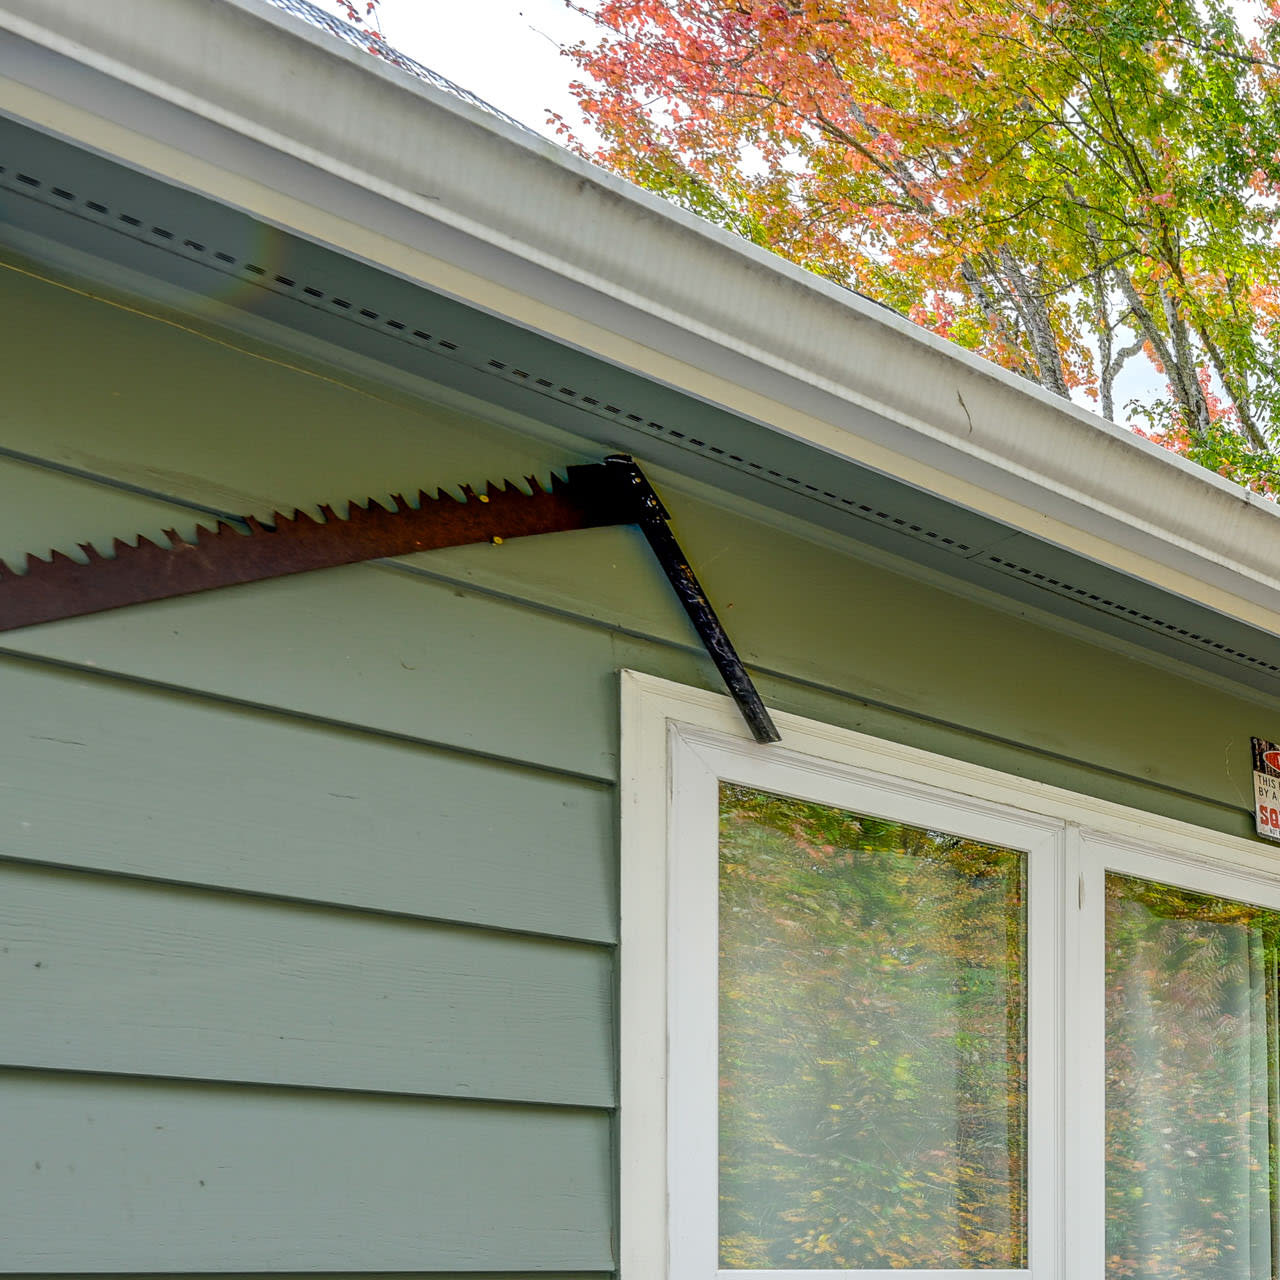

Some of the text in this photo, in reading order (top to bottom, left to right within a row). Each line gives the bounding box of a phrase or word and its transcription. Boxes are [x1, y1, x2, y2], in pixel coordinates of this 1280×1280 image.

[1258, 775, 1276, 788] THIS
[1258, 786, 1269, 798] BY
[1272, 791, 1278, 801] A
